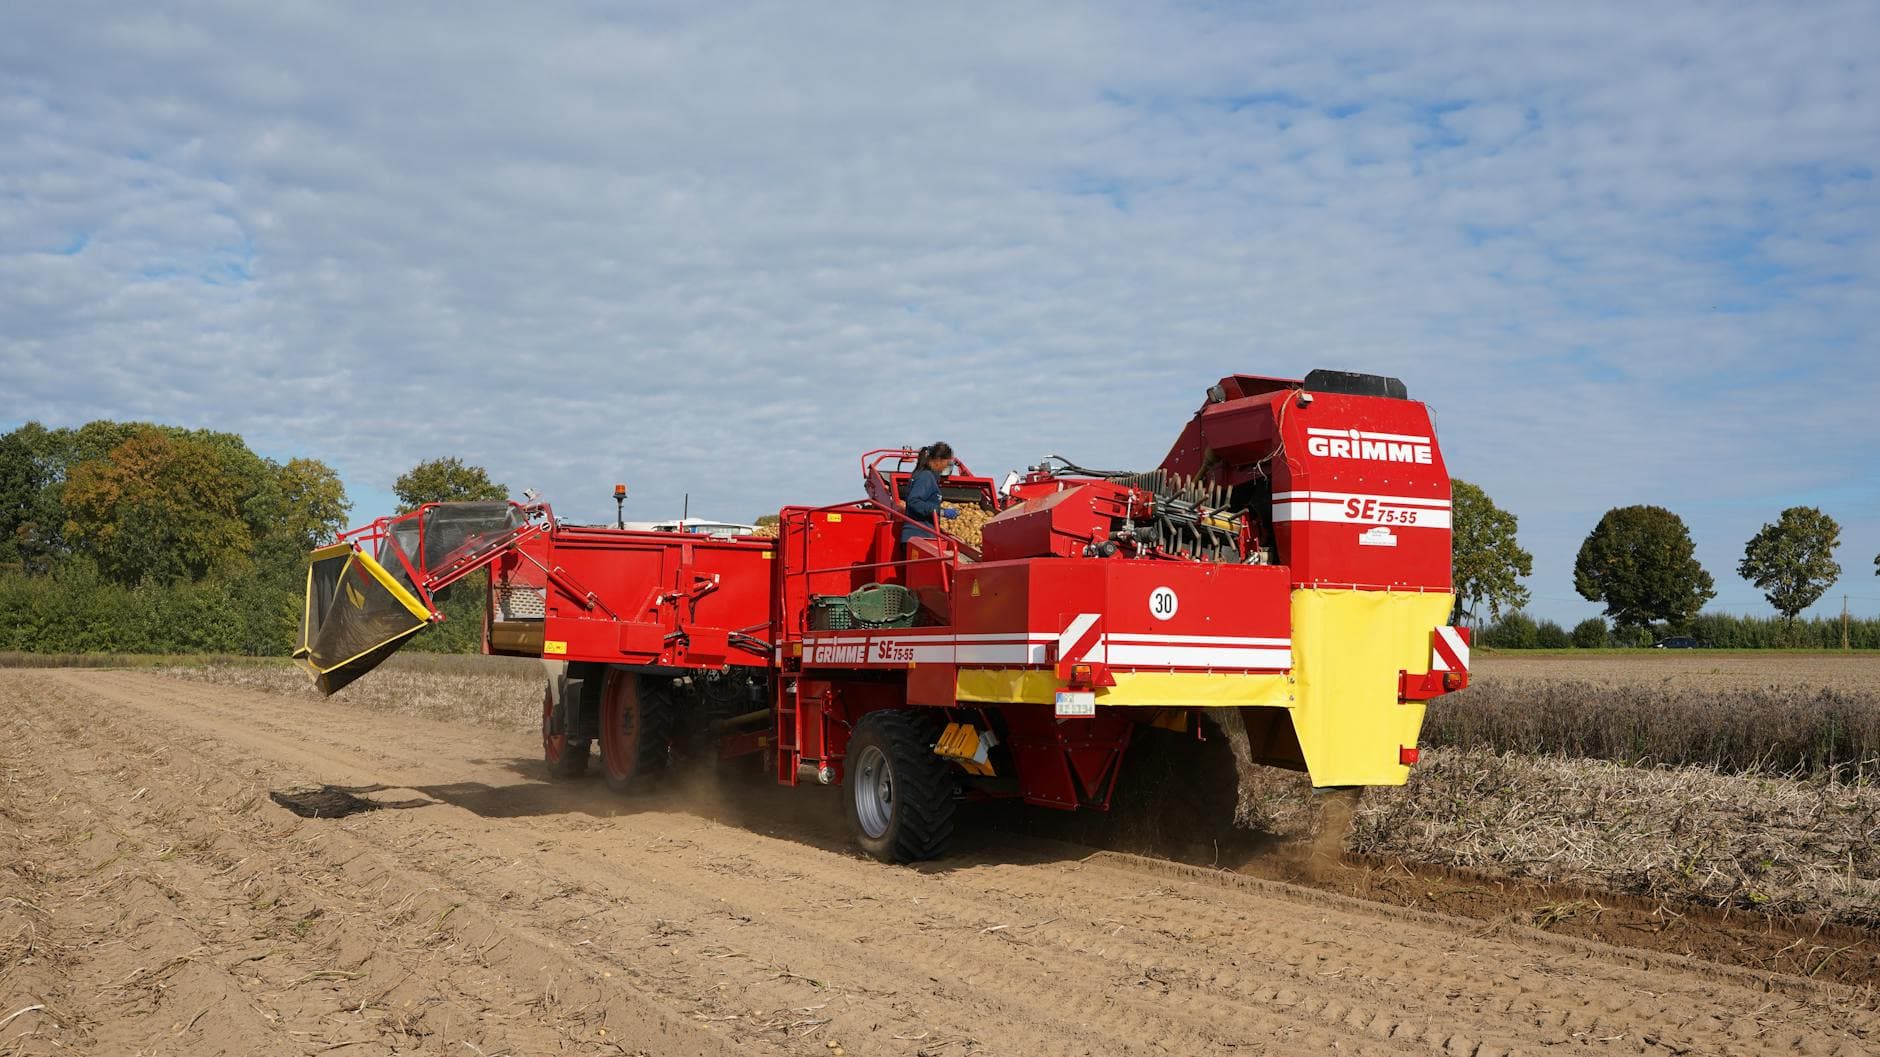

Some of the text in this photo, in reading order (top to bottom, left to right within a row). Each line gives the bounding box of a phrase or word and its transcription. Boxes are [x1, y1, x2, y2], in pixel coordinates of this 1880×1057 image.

[1307, 429, 1432, 465] GRIMME
[1344, 498, 1417, 524] SE 75-55
[1155, 593, 1172, 614] 30
[815, 638, 914, 663] GRIMME SE 75-55
